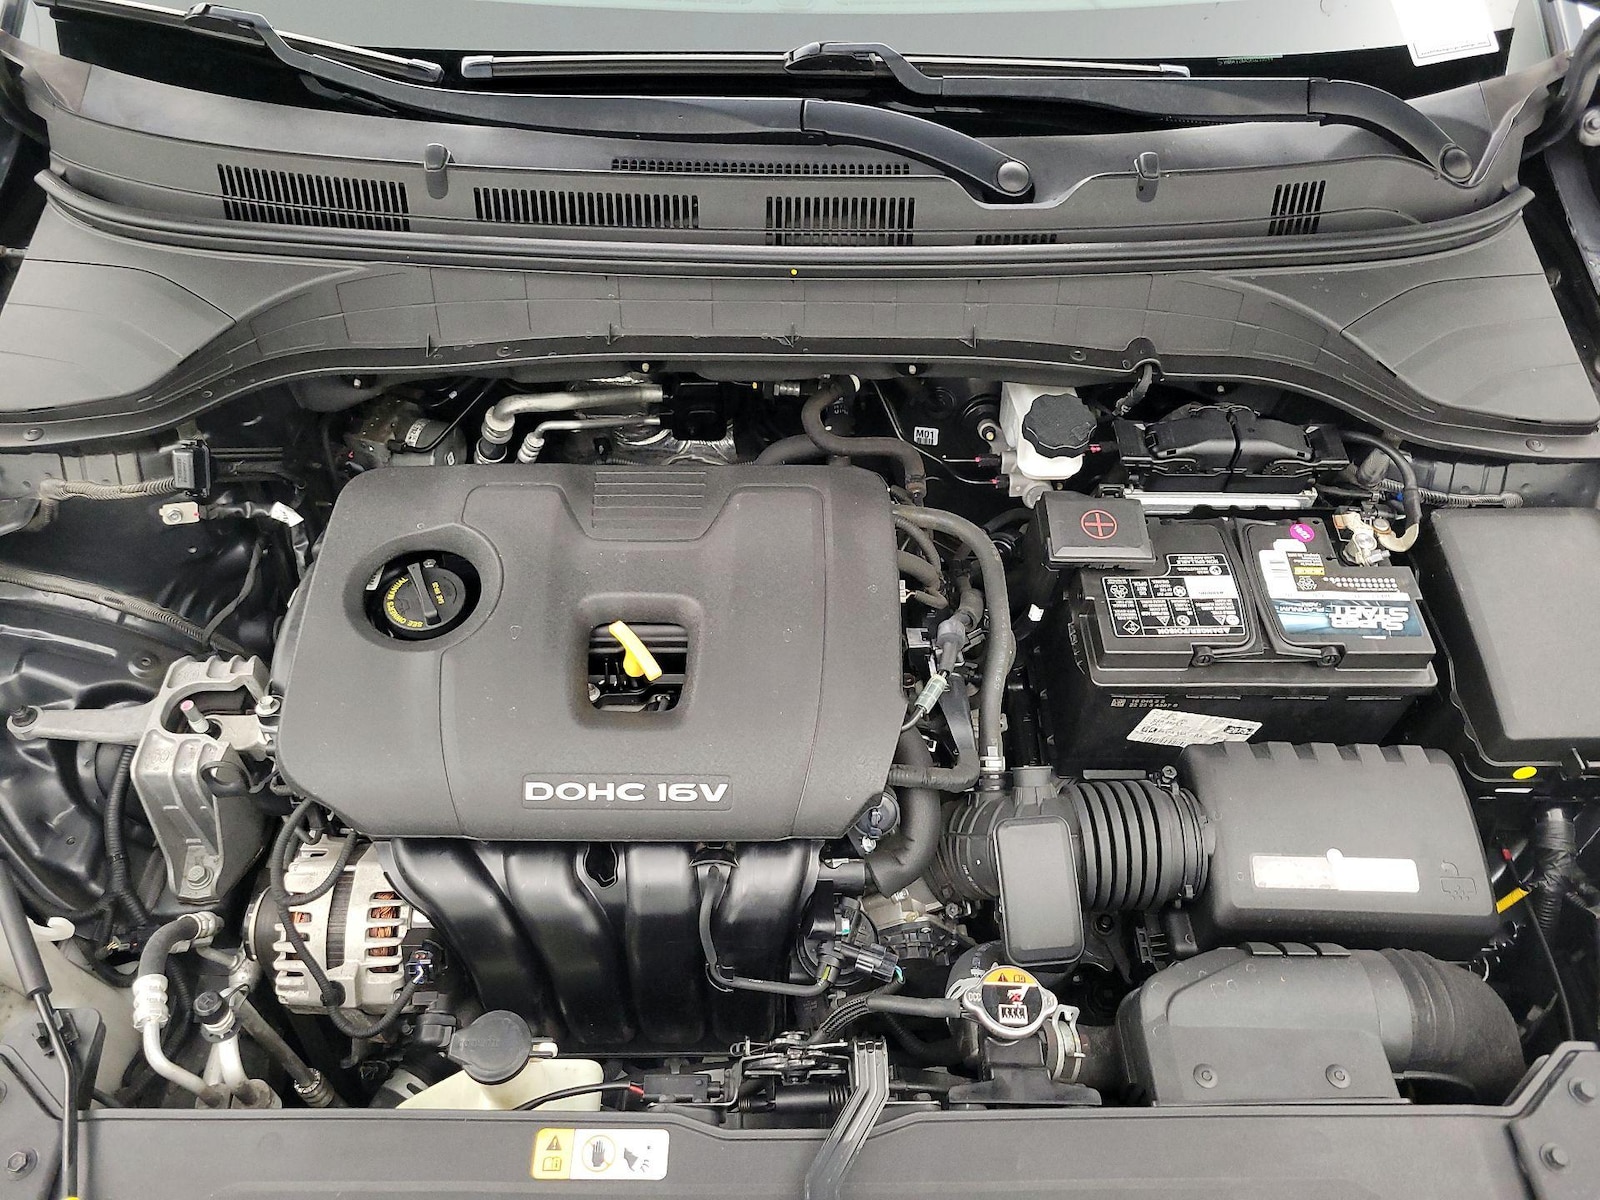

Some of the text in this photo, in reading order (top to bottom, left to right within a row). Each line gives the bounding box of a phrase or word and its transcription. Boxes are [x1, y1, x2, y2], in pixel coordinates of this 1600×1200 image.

[916, 429, 934, 438] M01
[387, 577, 409, 600] MANUAL
[1332, 606, 1409, 622] START
[406, 620, 424, 628] SEE
[1331, 617, 1404, 631] SUPER
[524, 781, 729, 802] DOHC 16V
